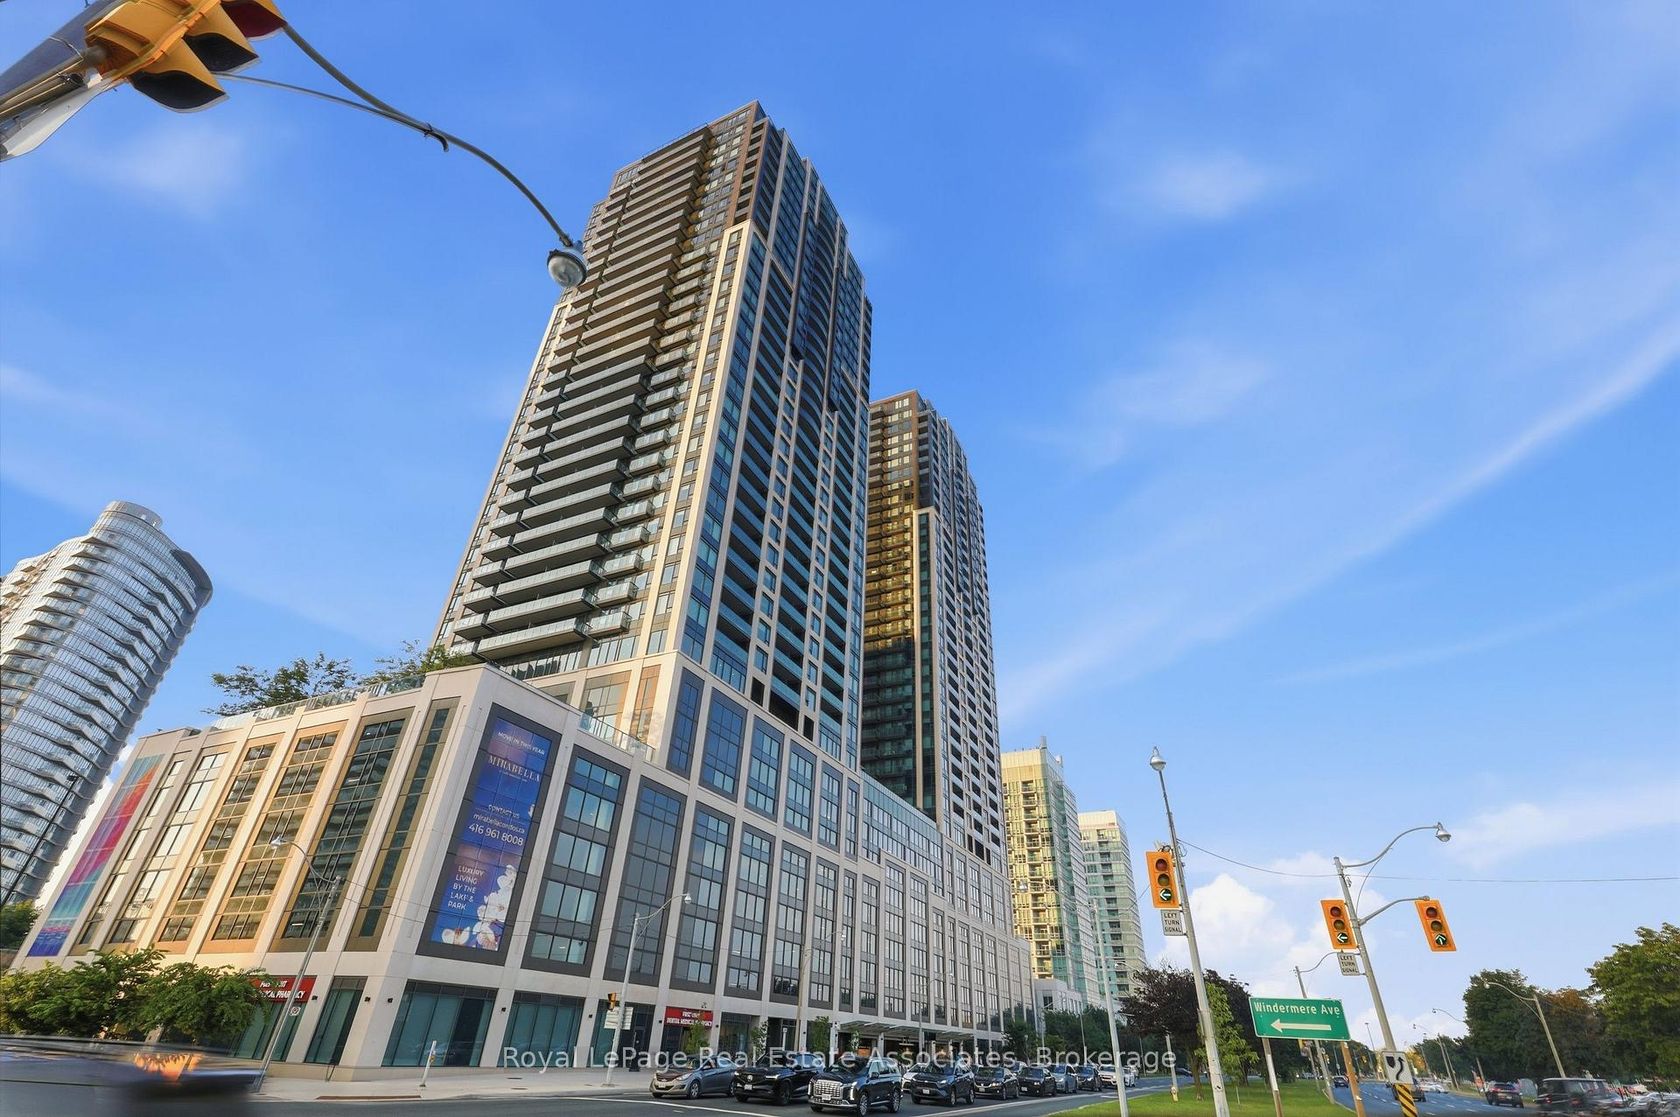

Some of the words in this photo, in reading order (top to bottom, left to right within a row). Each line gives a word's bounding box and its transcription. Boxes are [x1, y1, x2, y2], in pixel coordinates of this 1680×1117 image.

[489, 755, 540, 782] MIRABELLA
[488, 804, 512, 816] CONTACT
[469, 823, 485, 835] 416
[485, 827, 500, 839] 961
[501, 832, 524, 846] 8008
[458, 865, 485, 876] LUXURY
[455, 874, 478, 885] LIVING
[453, 882, 463, 891] BY
[464, 884, 477, 894] THE
[450, 891, 468, 901] LAKE
[447, 900, 467, 910] PARK
[1253, 1002, 1317, 1014] Windermere
[1321, 1004, 1340, 1015] Ave
